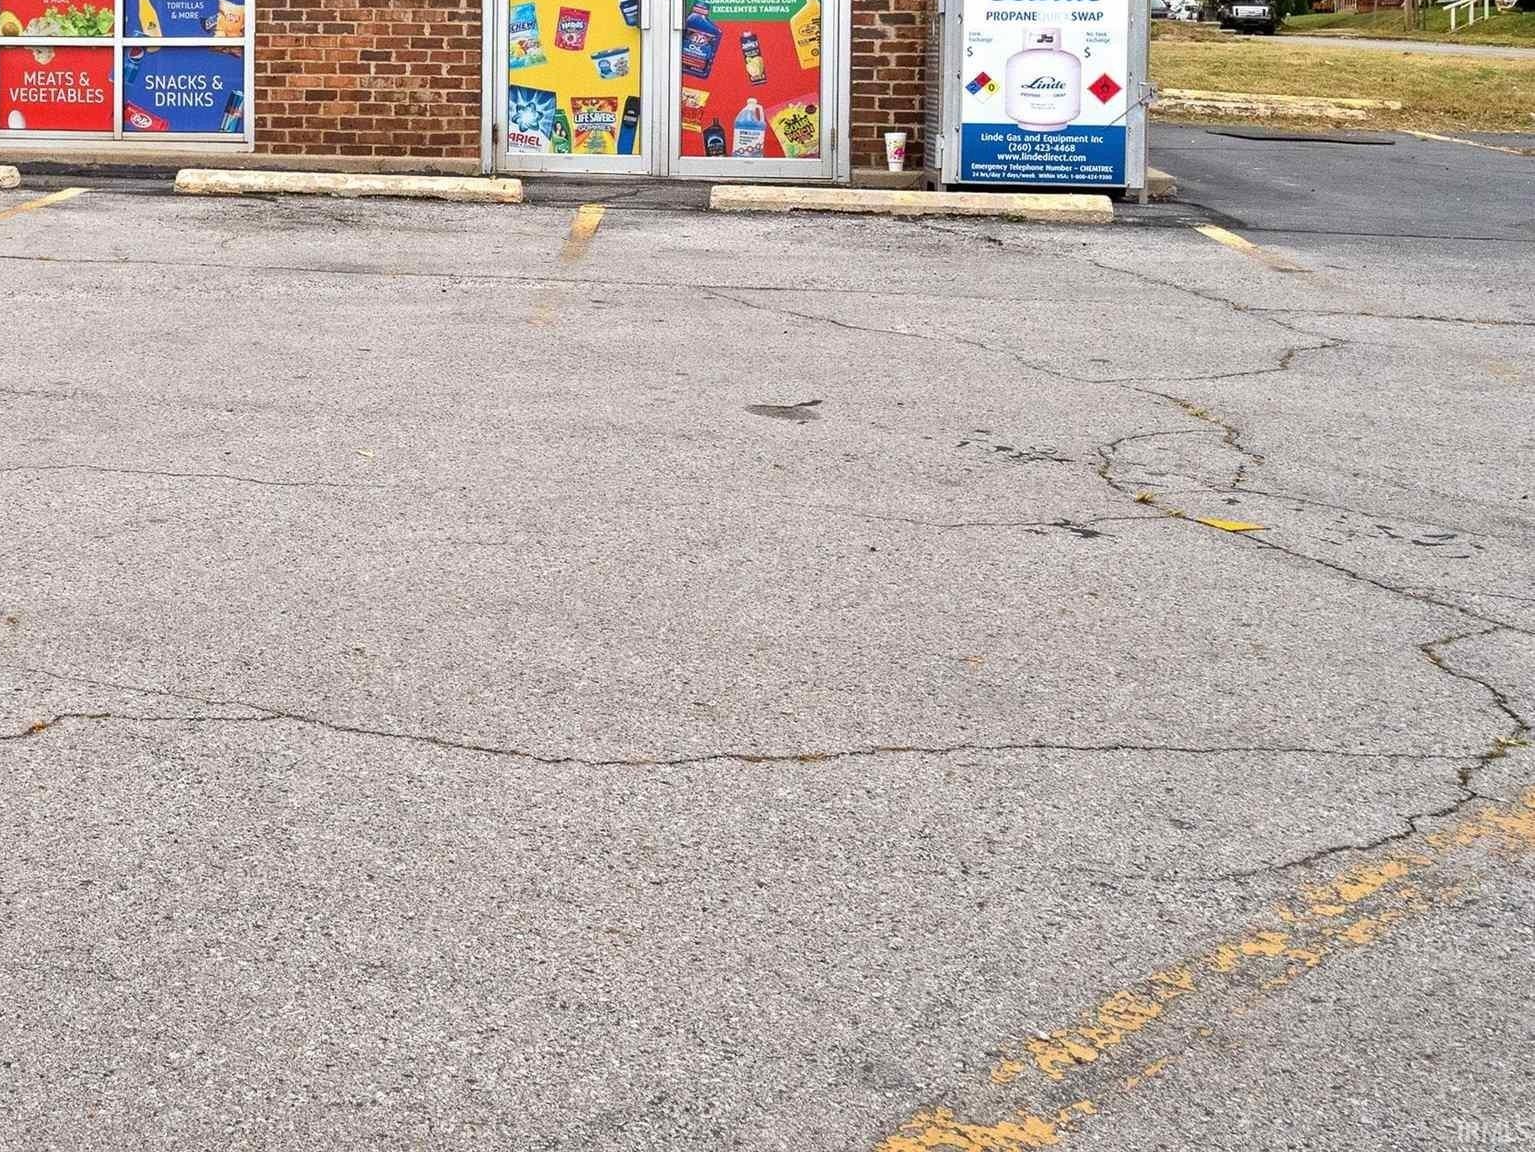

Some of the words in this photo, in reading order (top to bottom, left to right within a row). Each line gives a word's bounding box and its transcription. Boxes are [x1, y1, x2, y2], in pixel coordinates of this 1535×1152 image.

[986, 11, 1037, 21] PROPANE
[1071, 11, 1104, 21] SWAP
[24, 72, 74, 85] MEATS
[79, 72, 90, 85] &
[145, 75, 206, 90] SNACKS
[212, 75, 224, 90] &
[1021, 76, 1066, 89] Linde
[9, 88, 105, 103] VEGETABLES
[155, 91, 214, 107] DRINKS
[508, 132, 542, 146] ARIEL
[981, 133, 1004, 141] Linde
[1007, 133, 1022, 142] Gas
[1024, 134, 1040, 142] and
[1044, 134, 1088, 144] Equipment
[1091, 135, 1103, 143] Inc
[1008, 143, 1032, 152] (260)
[1035, 144, 1076, 152] 423-4468
[997, 152, 1086, 162] www.lindedirect.com
[1009, 163, 1043, 171] Telephone
